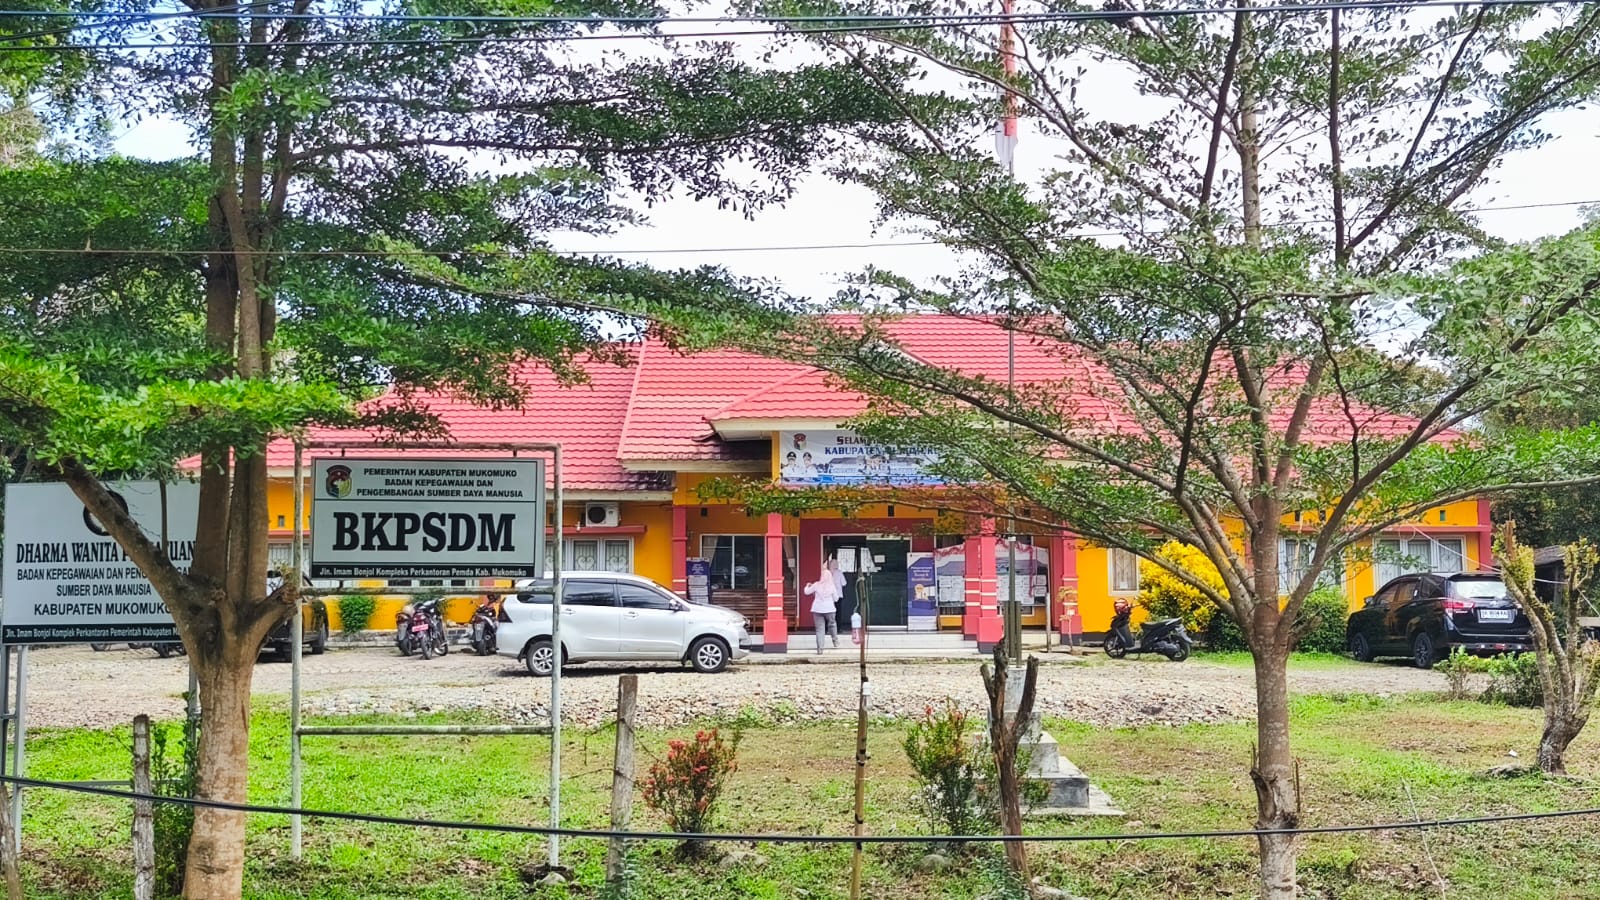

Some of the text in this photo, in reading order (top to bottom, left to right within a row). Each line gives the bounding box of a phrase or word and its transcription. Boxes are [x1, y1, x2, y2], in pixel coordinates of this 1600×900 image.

[363, 468, 517, 477] PEMERINTAH KABUPATEN MUKOMUKO
[384, 478, 493, 487] BADAN KEPEGAWAIAN DAN
[427, 489, 461, 497] SUMBER
[463, 489, 483, 497] DAYA
[485, 490, 523, 498] MANUSIA
[332, 511, 516, 552] BKPSDM
[16, 543, 68, 563] DHARMA
[71, 541, 119, 562] WANITA
[17, 569, 45, 580] BADAN
[46, 568, 104, 580] KEPEGAWAIAN
[106, 568, 124, 579] DAN
[354, 569, 374, 577] Bonjol
[376, 569, 408, 577] Kompleks
[56, 584, 152, 596] SUMBER DAYA MANUSIA
[34, 603, 102, 616] KABUPATEN
[6, 629, 16, 638] Jln.
[17, 629, 32, 637] Imam
[34, 628, 50, 639] Bonjol
[52, 628, 75, 639] Komplek
[76, 628, 110, 637] Perkantoran
[110, 627, 141, 637] Pemerintah
[142, 627, 171, 638] Kabupaten
